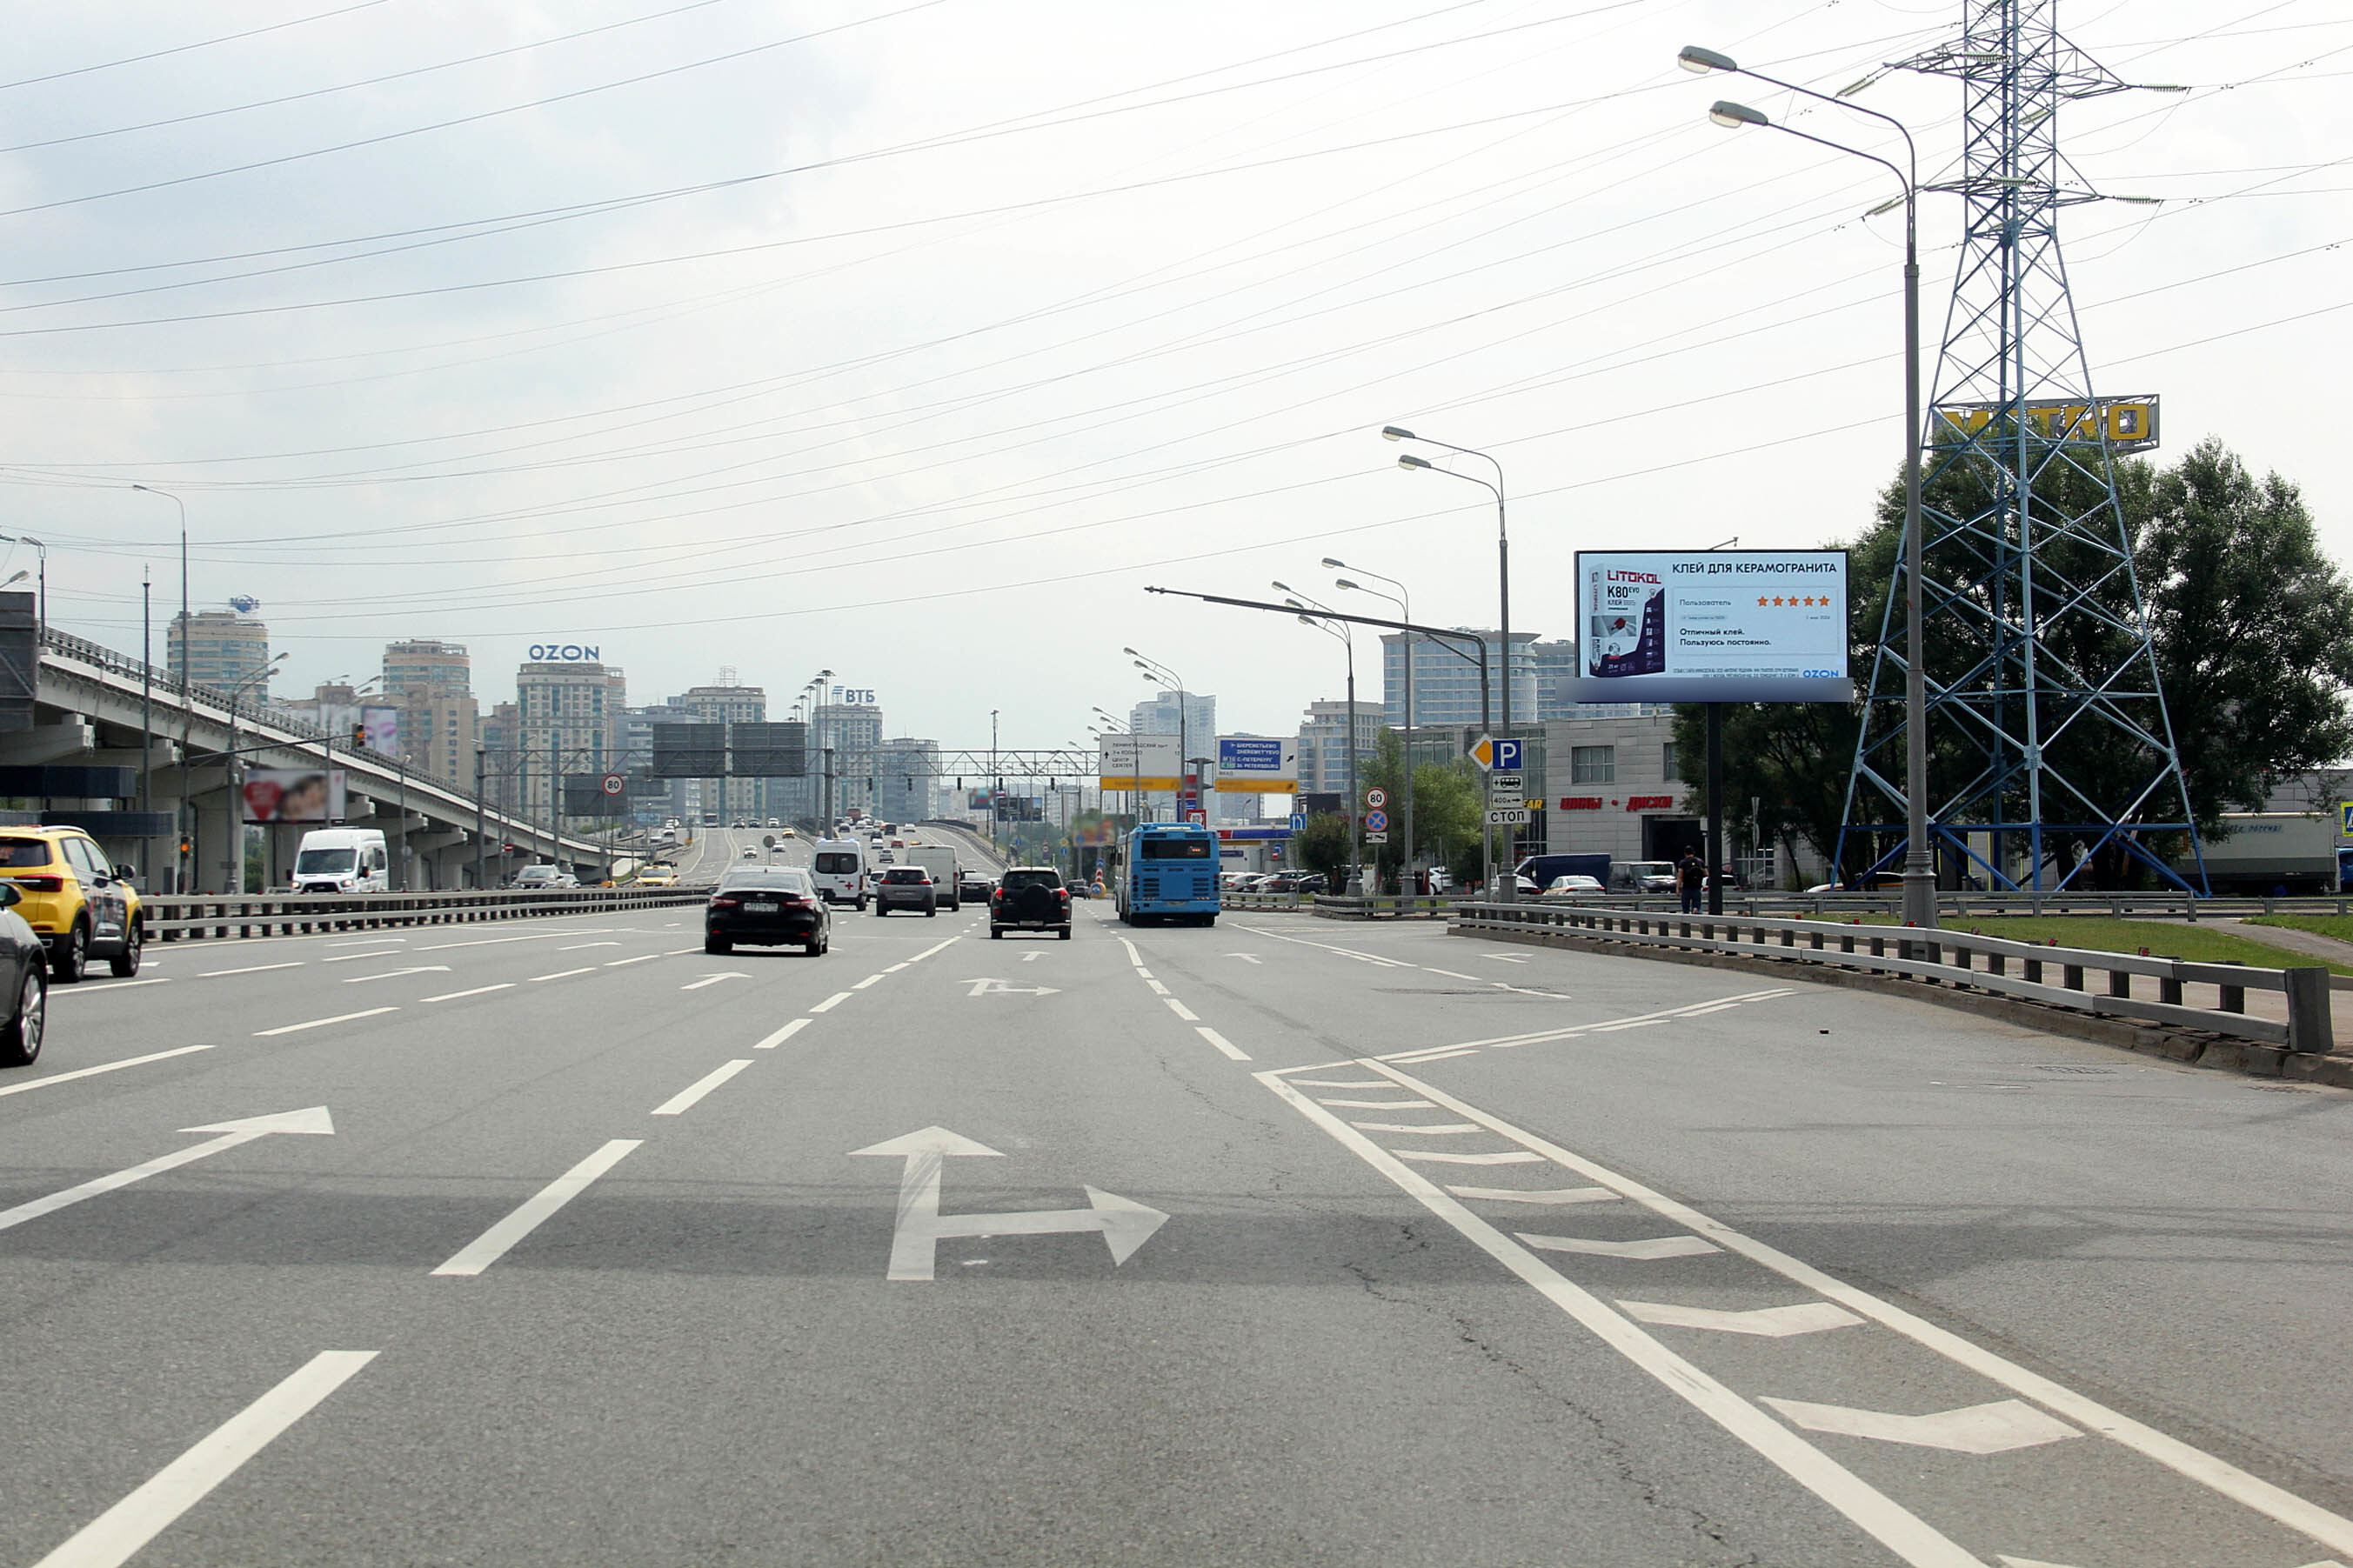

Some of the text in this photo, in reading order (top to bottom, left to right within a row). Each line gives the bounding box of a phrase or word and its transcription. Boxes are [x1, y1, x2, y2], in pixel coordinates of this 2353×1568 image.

[1942, 404, 2149, 442] MTRO
[1672, 563, 1836, 574] КЛЕЙ ДЛЯ КЕРАМОГРАНИТА
[1608, 570, 1661, 584] LITOKOL
[1608, 585, 1628, 598] K80
[530, 644, 599, 661] OZON
[846, 689, 875, 703] ВТБ
[1500, 743, 1517, 767] P
[607, 780, 619, 789] 80
[1370, 794, 1381, 803] 80
[1560, 796, 1673, 811] ШИНЫ ДИСКИ
[1490, 811, 1524, 823] СТОП
